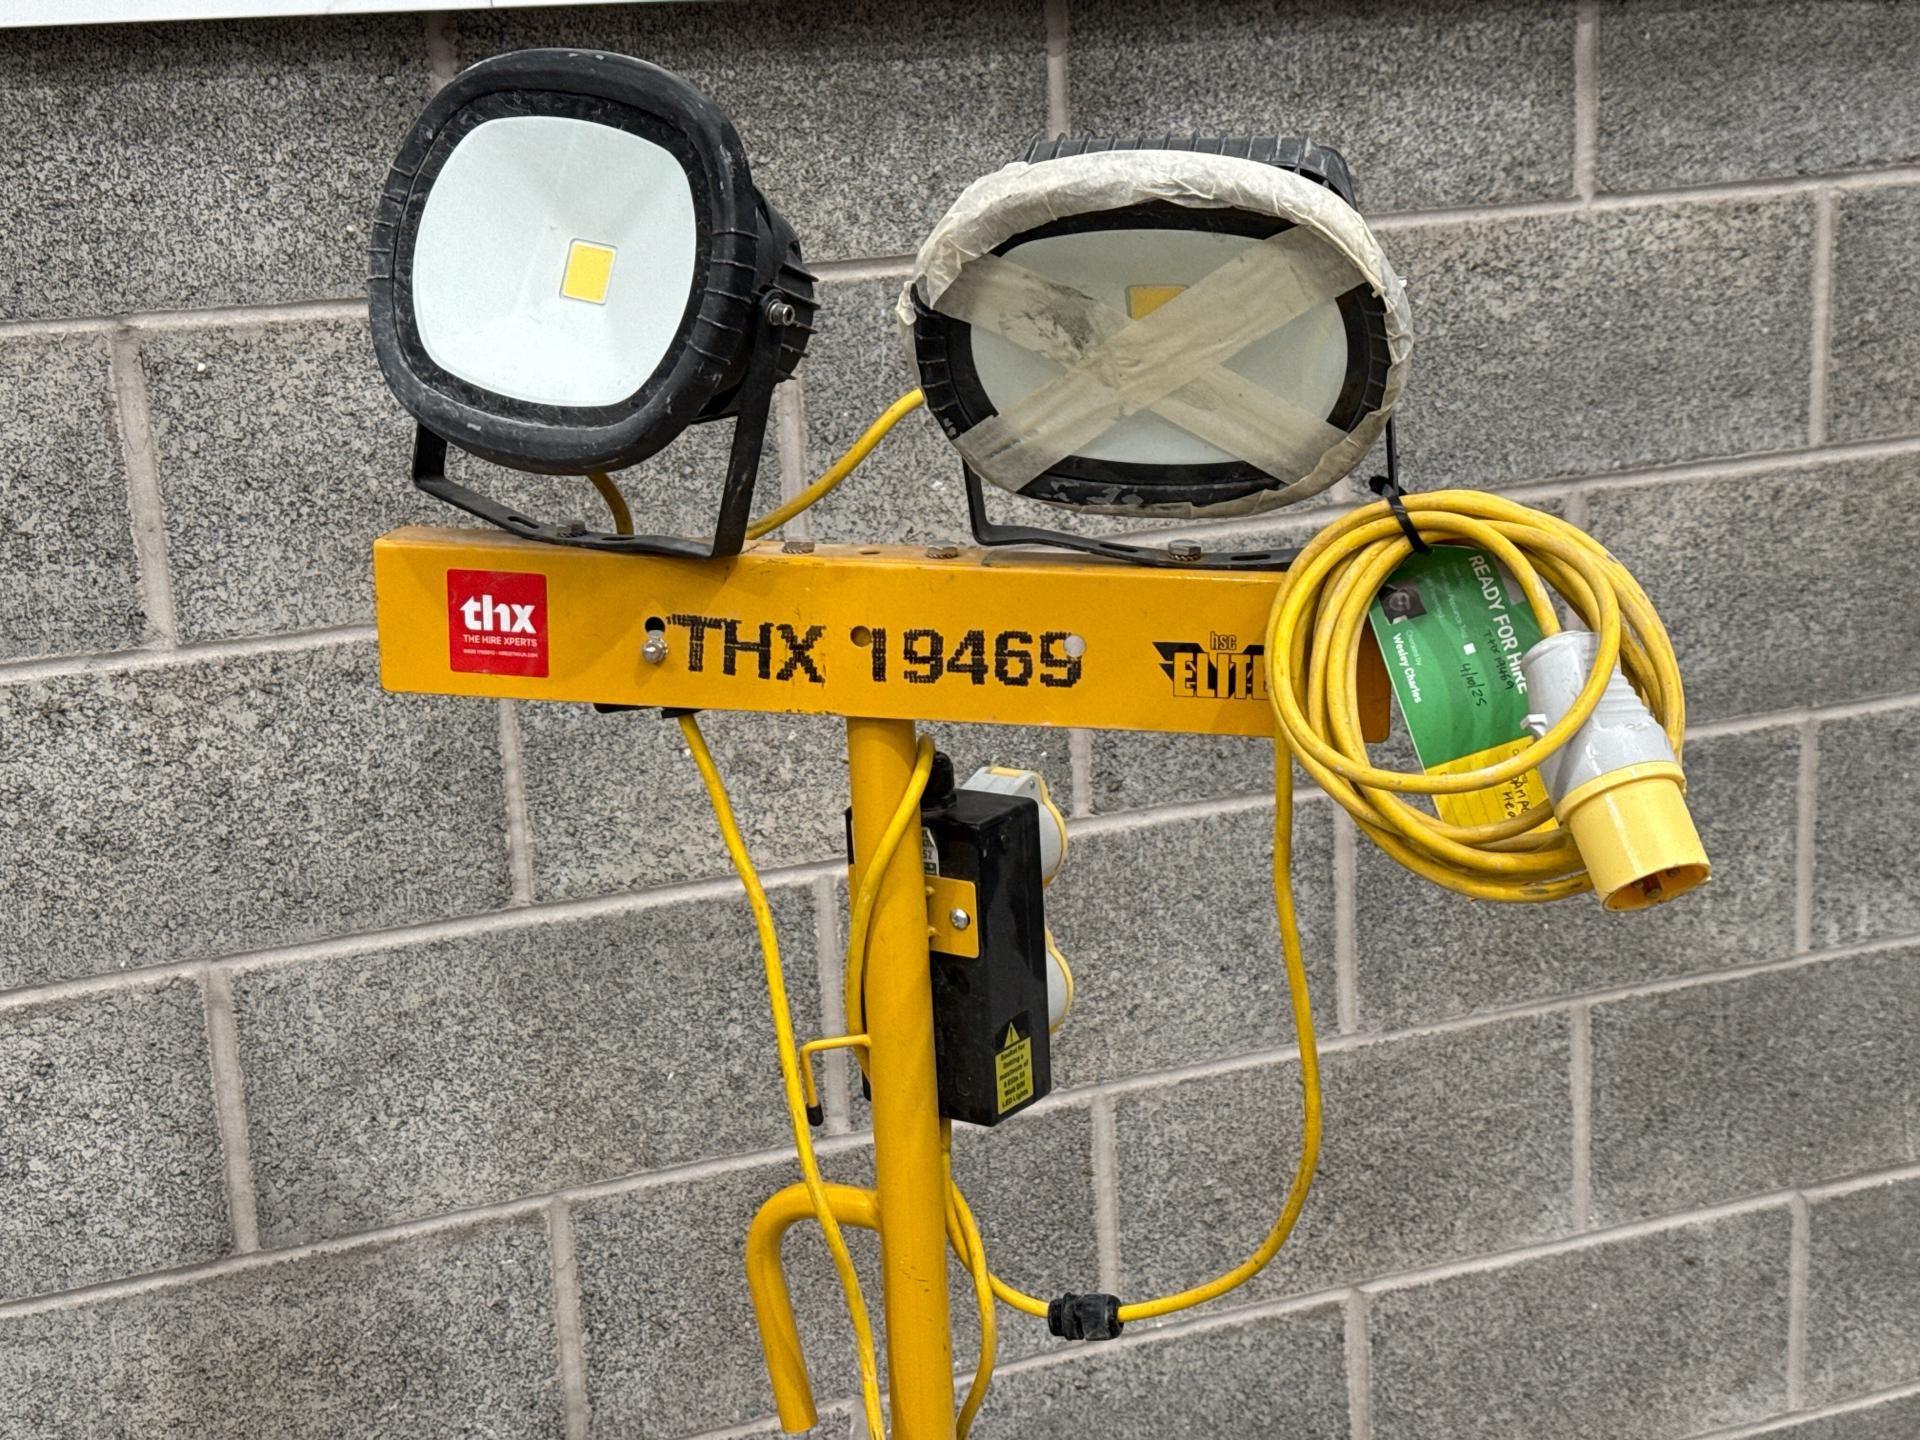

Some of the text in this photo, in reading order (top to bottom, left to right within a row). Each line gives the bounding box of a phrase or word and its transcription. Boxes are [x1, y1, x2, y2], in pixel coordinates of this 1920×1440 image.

[460, 594, 537, 634] thx
[463, 634, 538, 648] THE HIRE XPERTS
[1210, 630, 1237, 650] hsc
[1468, 555, 1528, 694] READY FOR HIRE
[666, 614, 1082, 688] THX 19469
[1393, 632, 1422, 704] Wesley Charles
